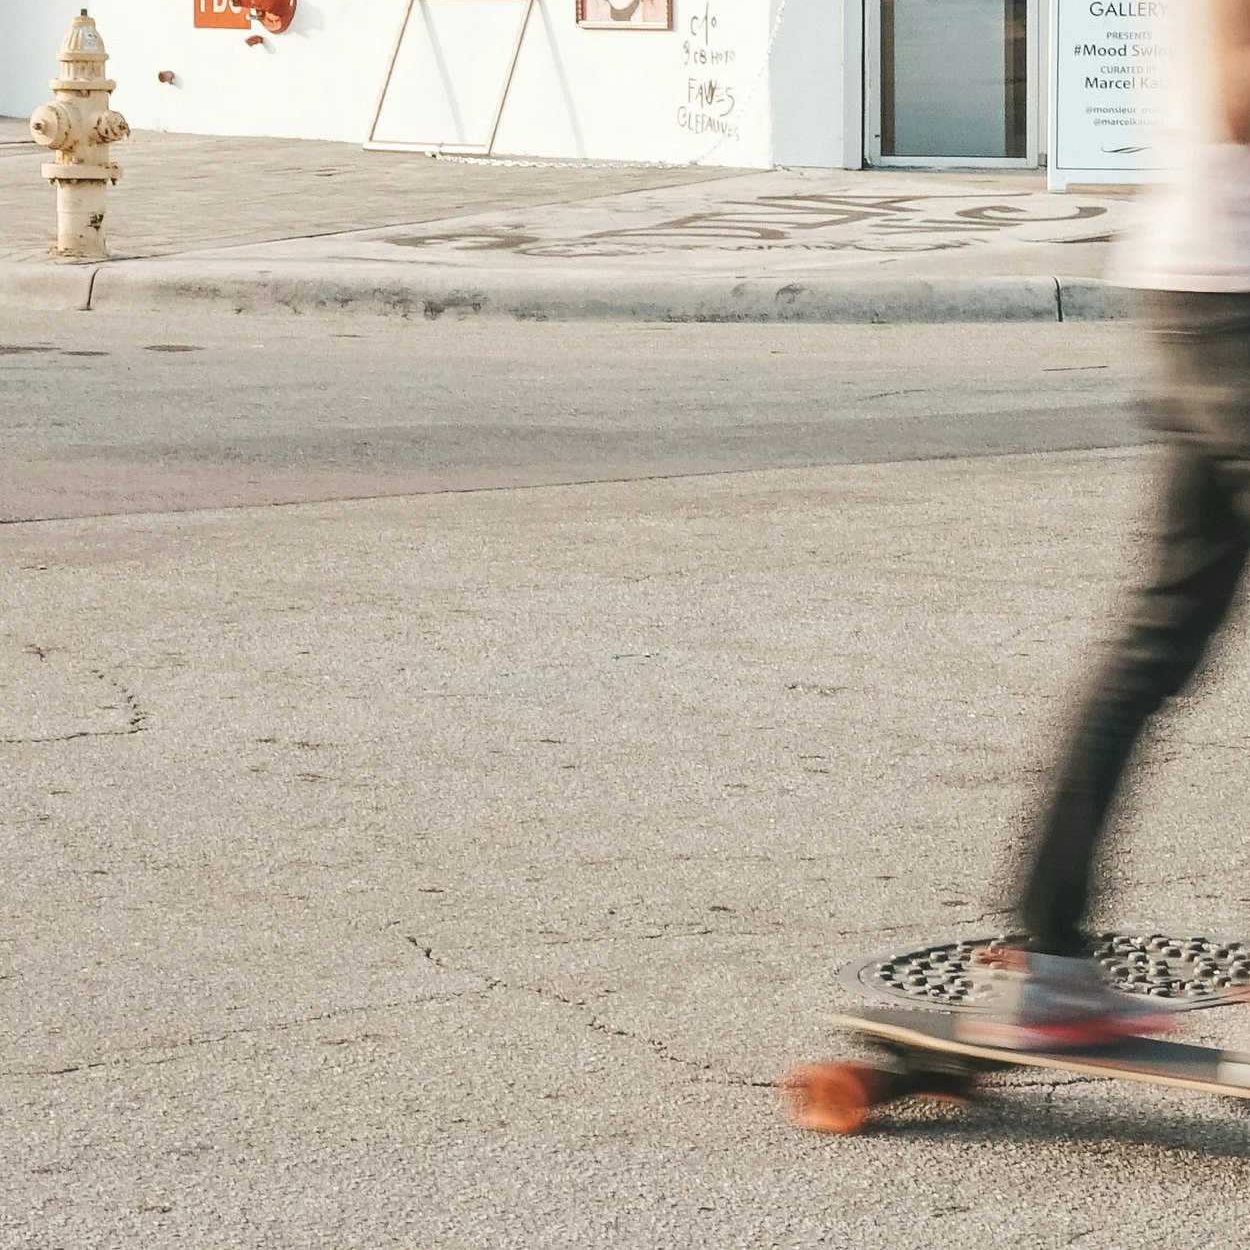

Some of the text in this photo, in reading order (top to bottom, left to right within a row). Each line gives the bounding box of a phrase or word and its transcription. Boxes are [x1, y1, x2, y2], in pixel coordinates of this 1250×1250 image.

[1089, 1, 1168, 17] GALLERY
[1106, 31, 1153, 40] PRESENTS
[1074, 44, 1127, 57] #Mood
[1100, 65, 1144, 74] CURATED
[1085, 76, 1136, 89] Marcel
